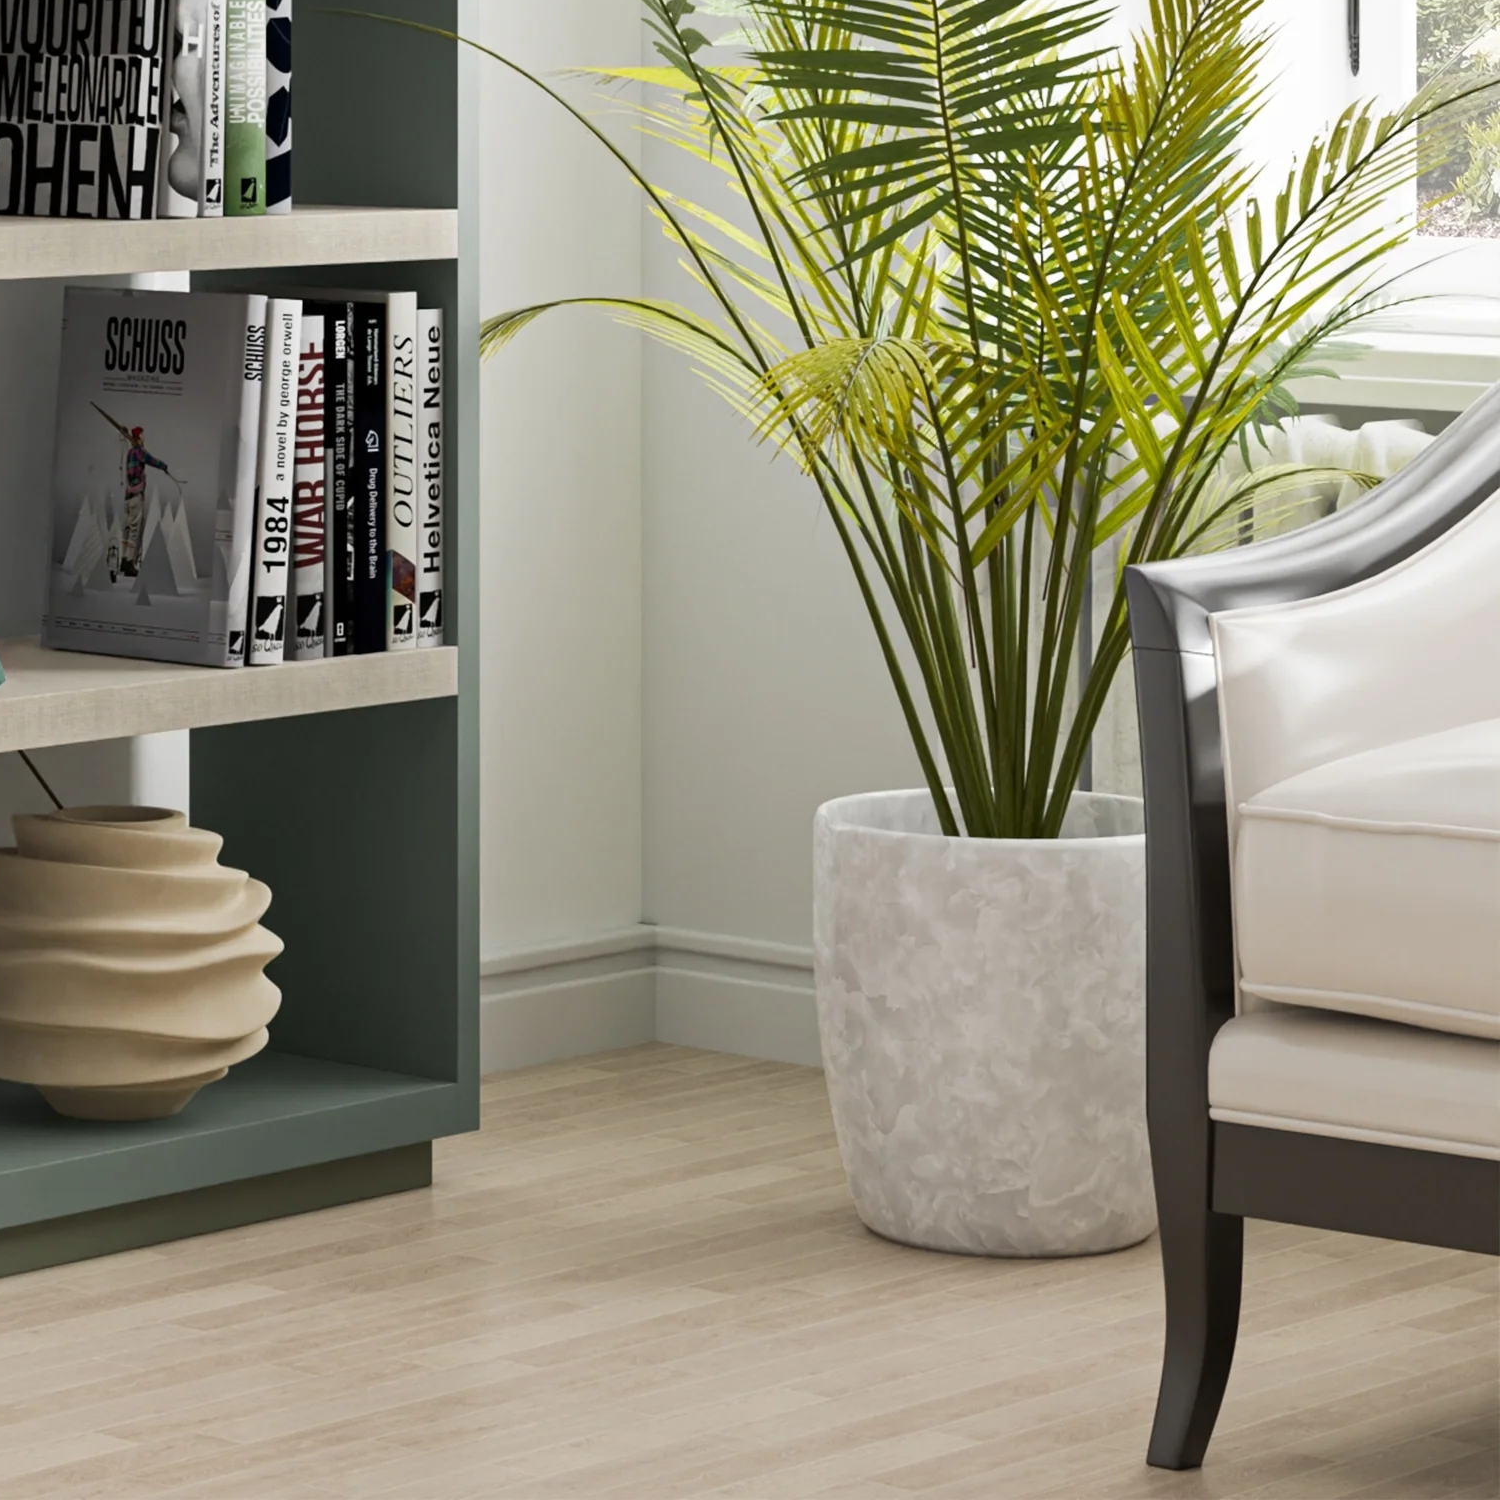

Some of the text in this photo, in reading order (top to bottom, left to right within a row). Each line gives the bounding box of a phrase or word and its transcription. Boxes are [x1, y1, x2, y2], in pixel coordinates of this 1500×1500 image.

[210, 2, 220, 21] of
[229, 0, 246, 124] UNIMAGINABLE
[246, 0, 265, 124] POSSIBILITIES
[210, 24, 221, 129] Adventures
[209, 132, 220, 167] The
[105, 317, 187, 374] SCHUSS
[245, 325, 265, 381] SCHUSS
[335, 321, 345, 358] LORGEN
[275, 313, 294, 482] a novel by george orwell
[335, 383, 345, 511] THE DARK SIDE OF CUPID
[393, 335, 413, 527] OUTLIERS
[424, 326, 441, 573] Helvetica Neue
[262, 496, 290, 574] 1984
[294, 479, 324, 569] WAR
[367, 468, 378, 578] Drug Delivery to the Brain
